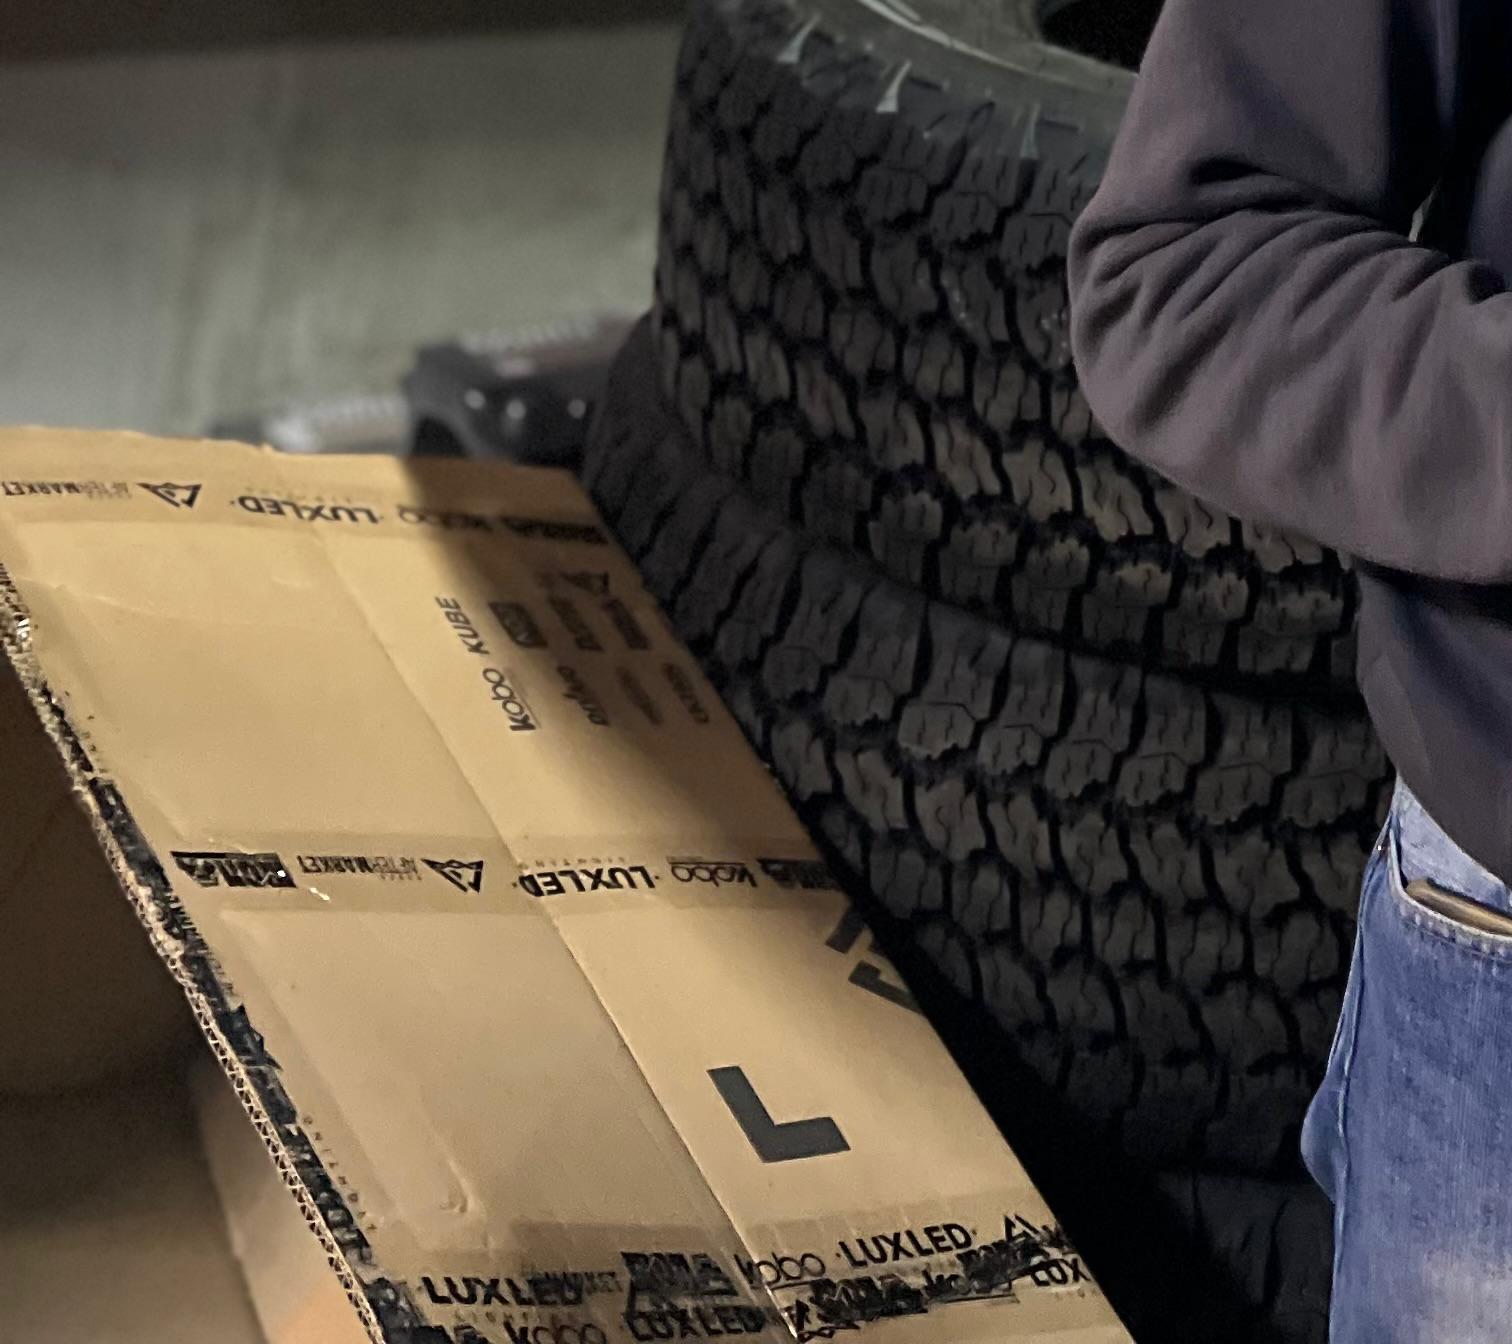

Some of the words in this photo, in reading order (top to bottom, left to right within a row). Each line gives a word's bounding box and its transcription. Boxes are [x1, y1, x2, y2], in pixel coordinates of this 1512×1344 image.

[238, 495, 379, 524] LUXLED
[434, 596, 491, 655] KUBE
[518, 866, 656, 897] LUXLED
[838, 1222, 972, 1267] LUXLED
